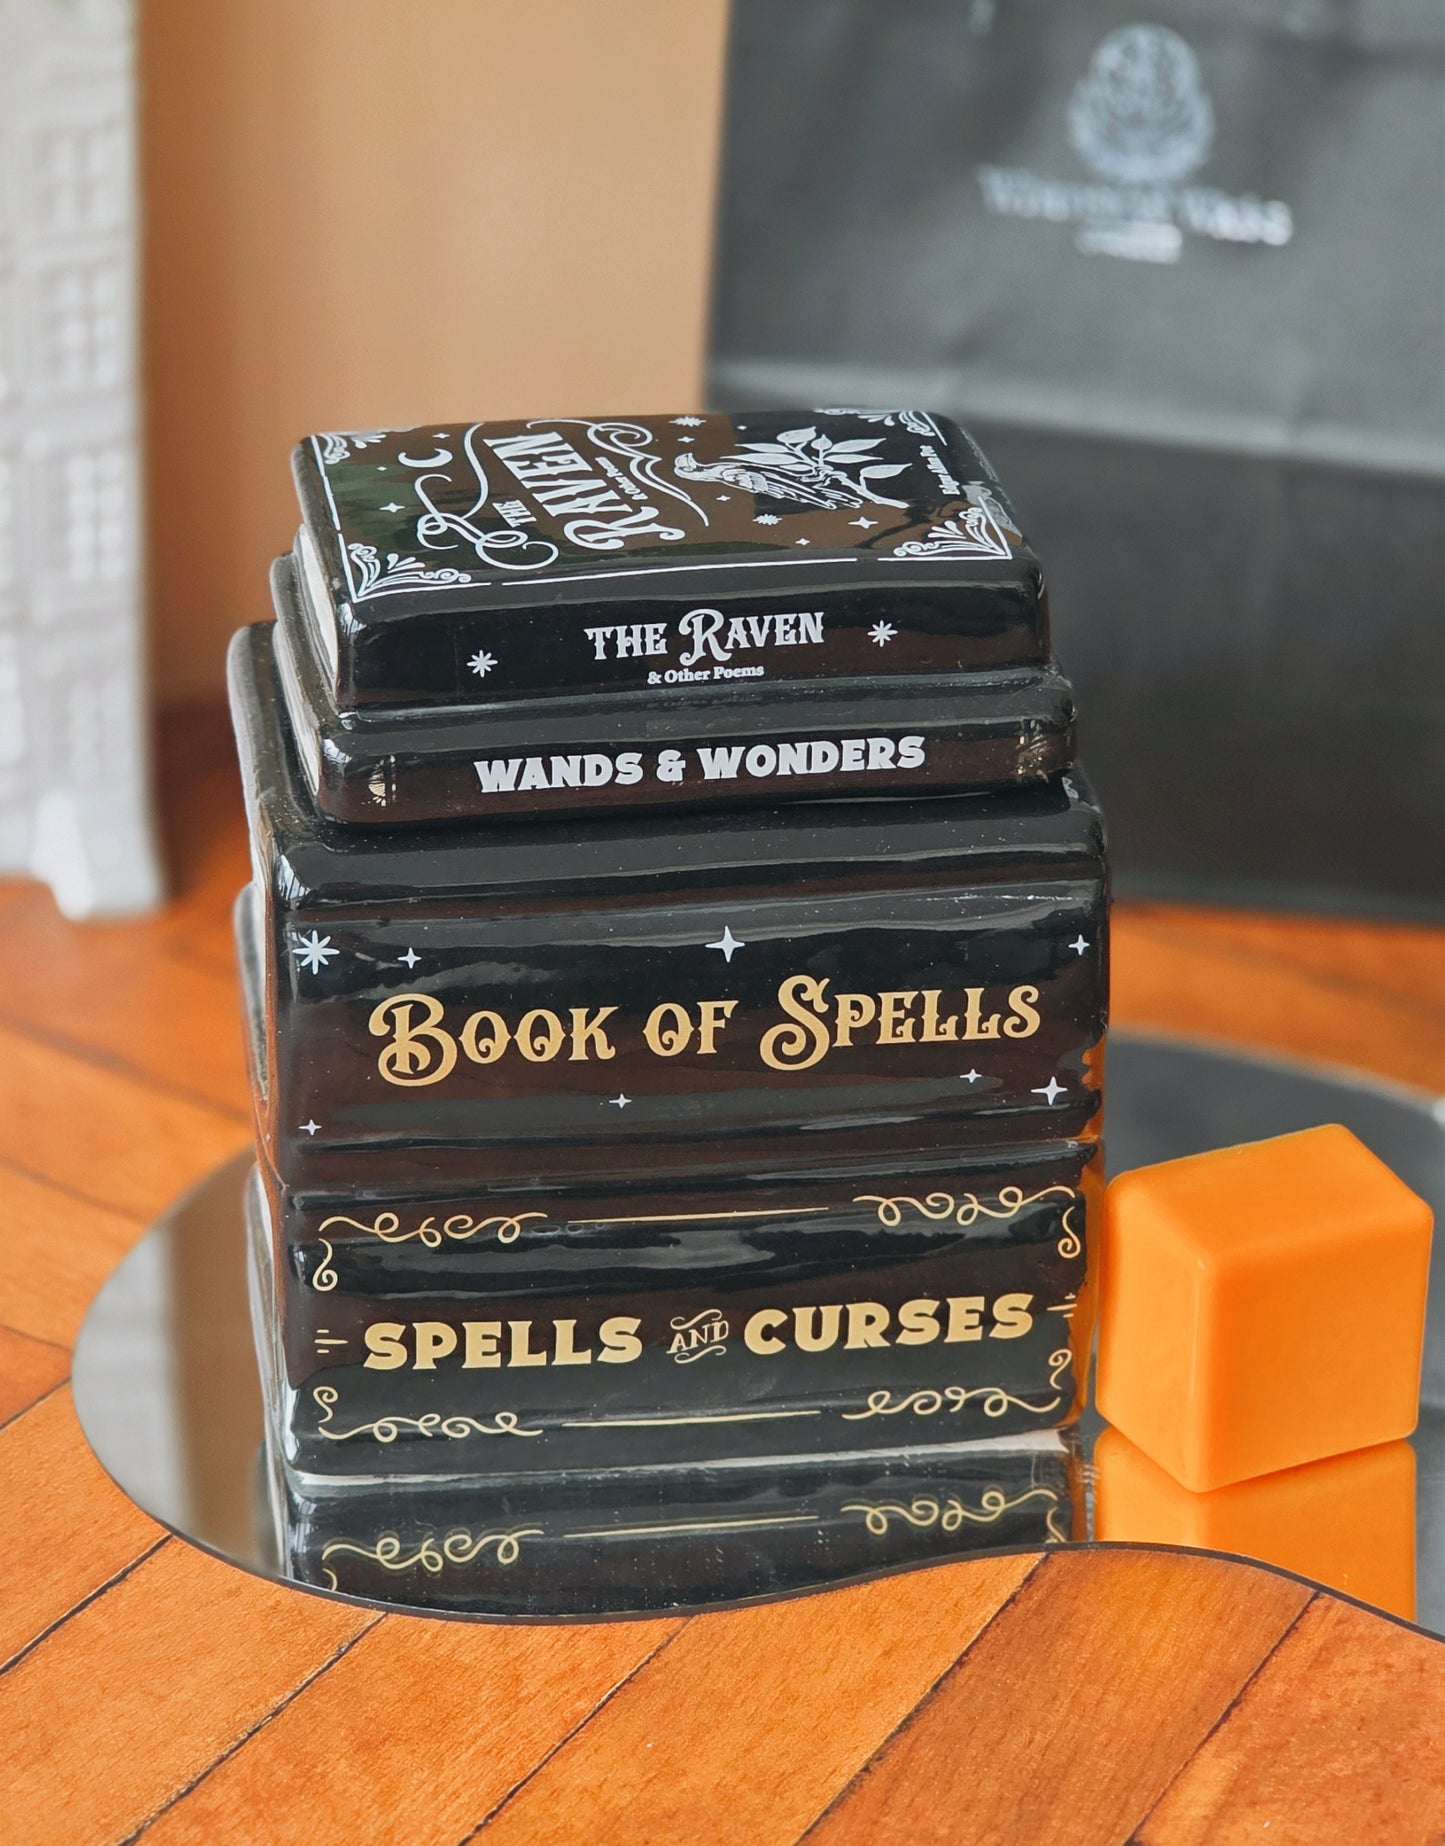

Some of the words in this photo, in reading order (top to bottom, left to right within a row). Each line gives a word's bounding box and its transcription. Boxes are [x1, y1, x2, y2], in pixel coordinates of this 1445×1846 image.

[483, 431, 686, 550] RAVEN
[492, 499, 538, 528] THE
[583, 622, 668, 660] THE
[647, 671, 662, 685] &
[664, 666, 711, 684] Other
[713, 665, 765, 680] Poems
[473, 752, 643, 794] WANDS
[656, 749, 687, 783] &
[696, 735, 926, 781] WONDERS
[642, 998, 739, 1057] OF
[363, 1315, 644, 1371] SPELLS
[666, 1320, 729, 1354] AND
[744, 1293, 1035, 1355] CURSES
